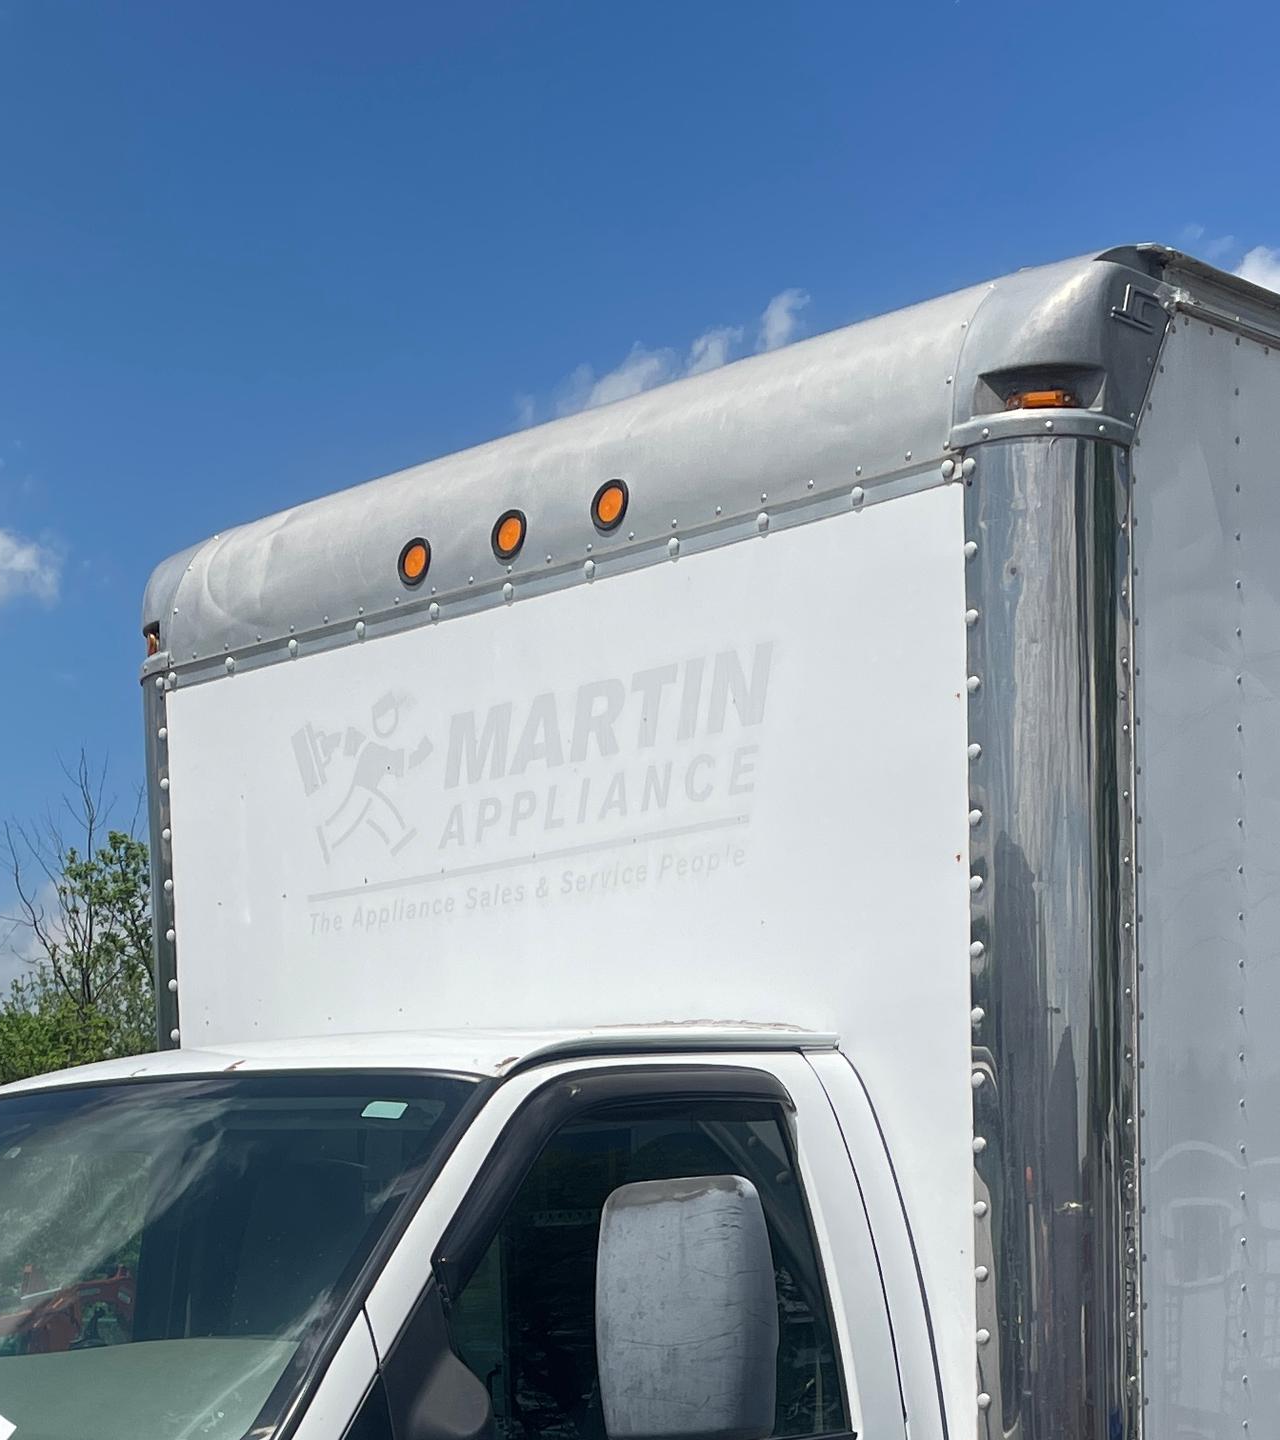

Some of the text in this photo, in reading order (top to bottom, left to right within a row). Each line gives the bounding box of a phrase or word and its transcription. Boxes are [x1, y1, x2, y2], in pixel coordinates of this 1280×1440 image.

[444, 641, 774, 789] MARTIN
[438, 745, 760, 849] APPLIANCE
[309, 910, 343, 936] The
[351, 894, 456, 930] Appliance
[465, 883, 525, 912] Sales
[535, 878, 550, 899] &
[560, 860, 648, 895] Service
